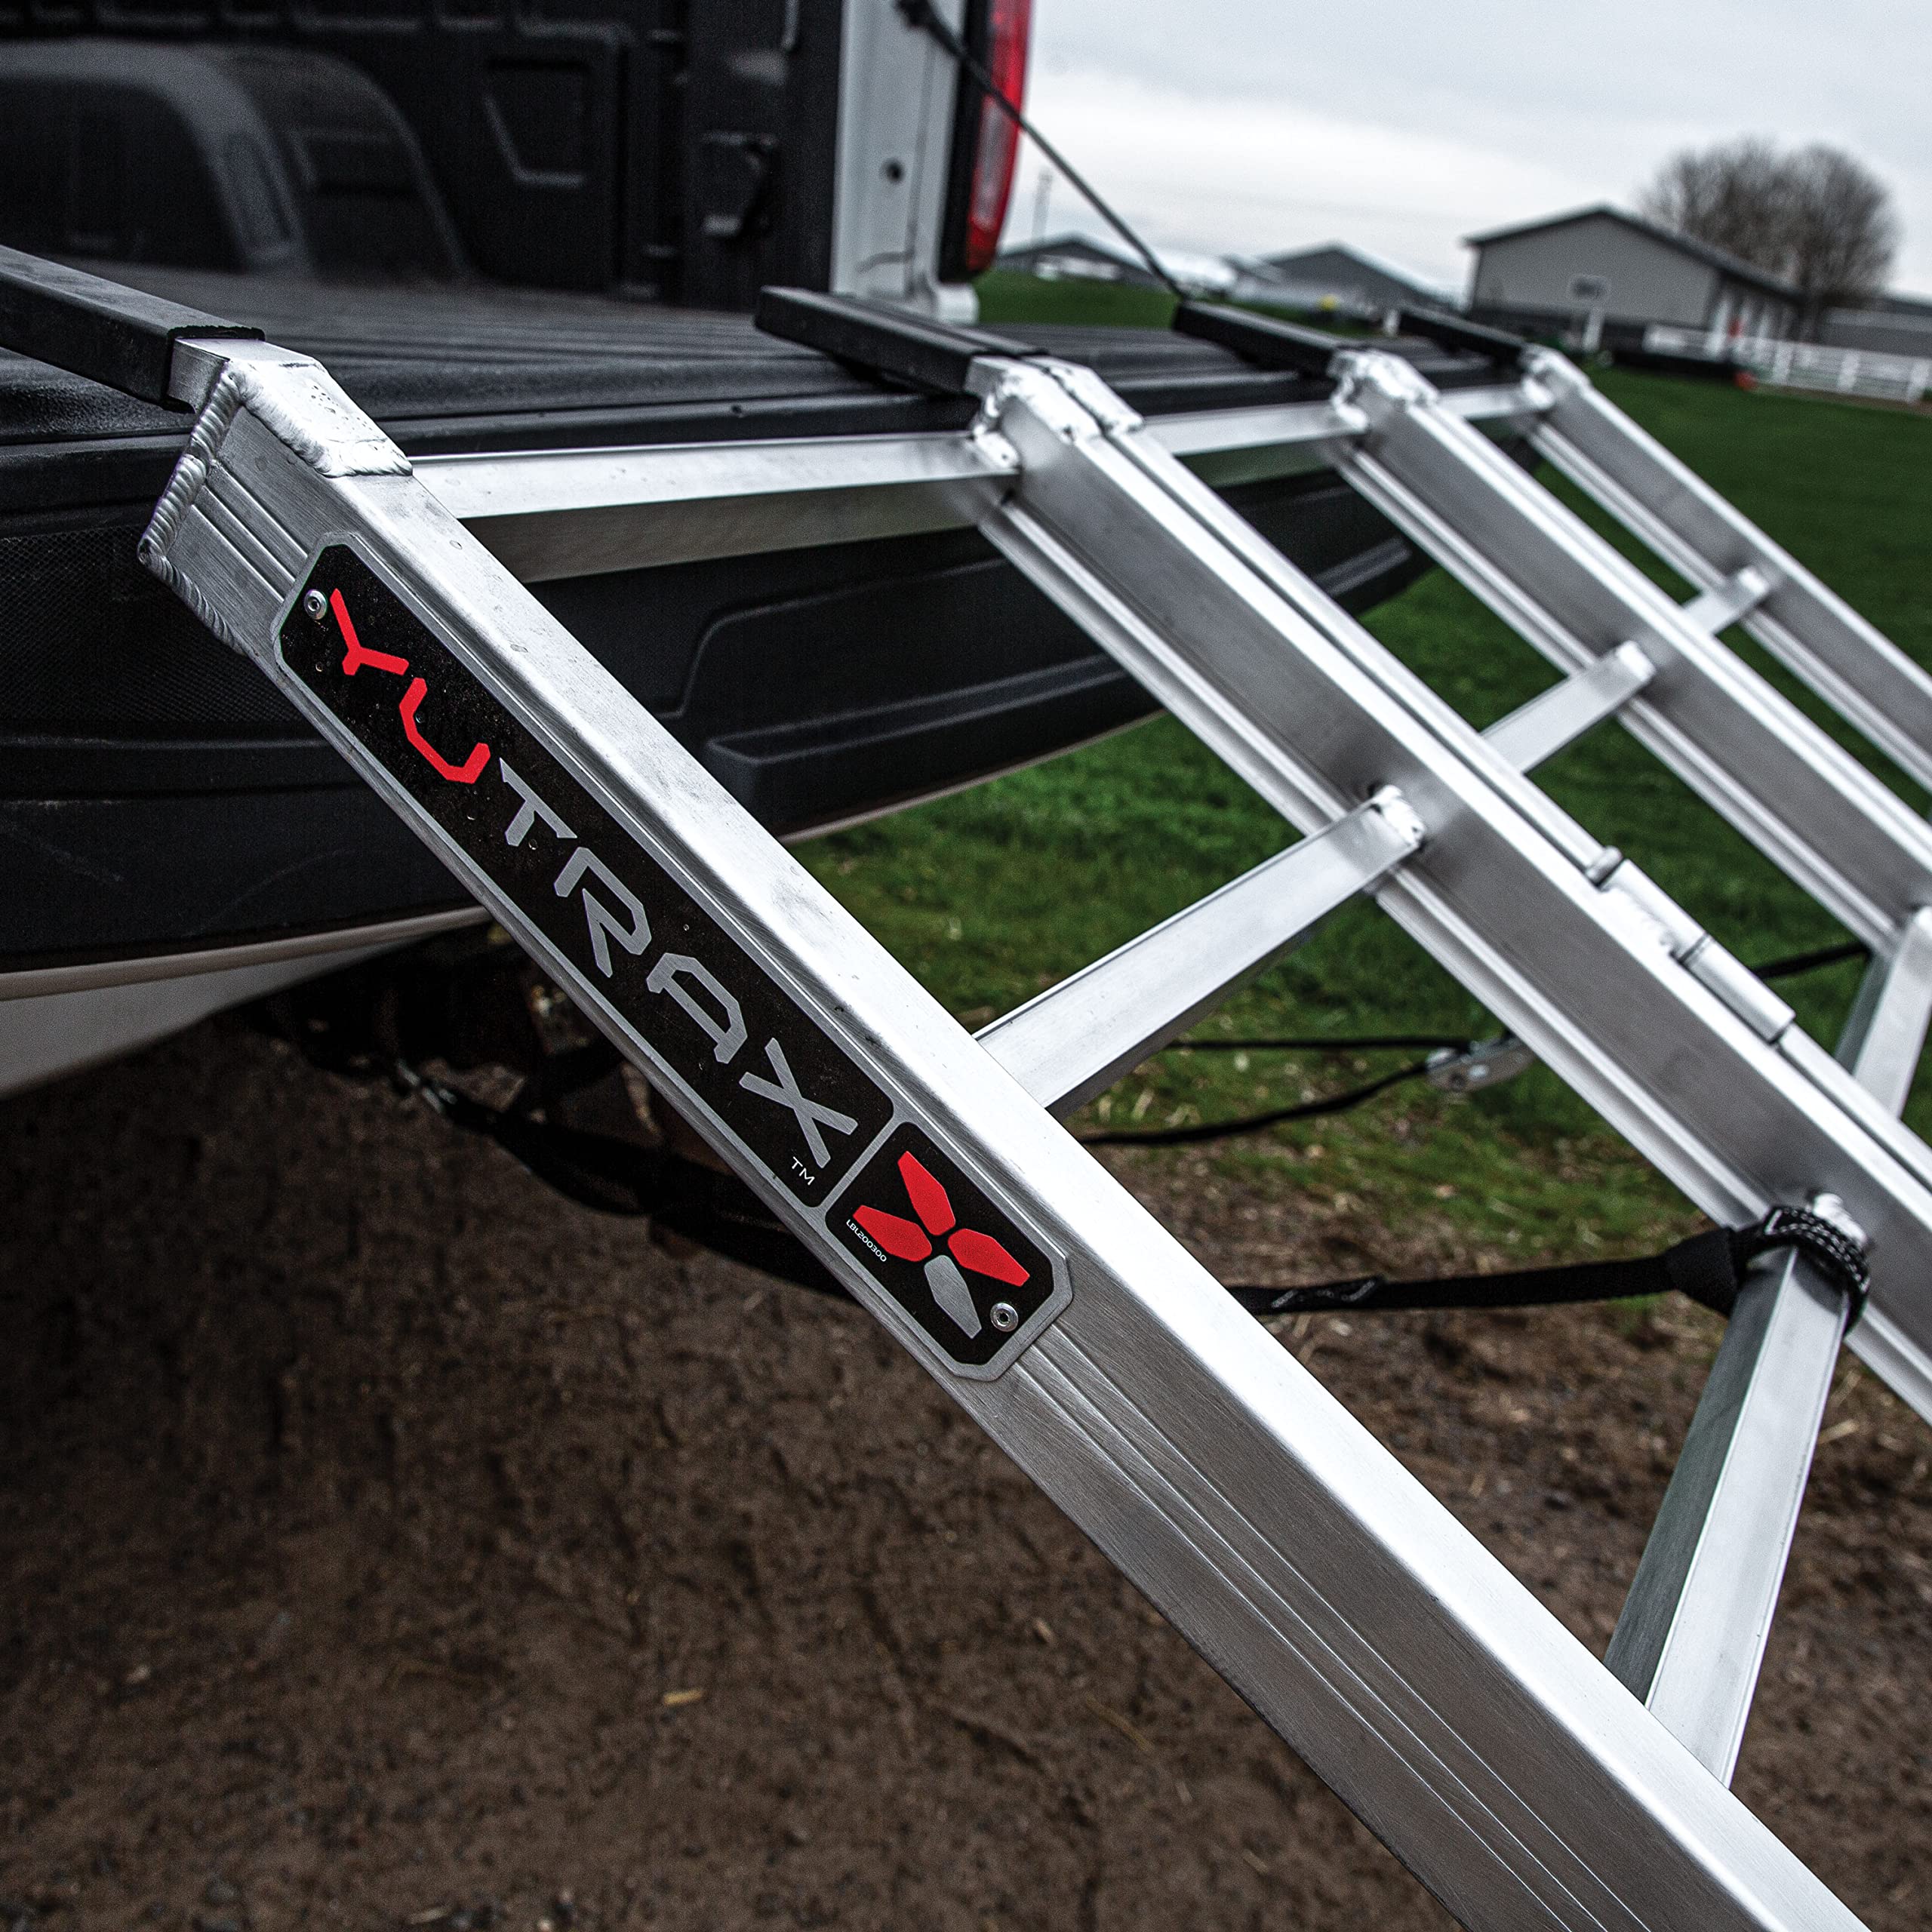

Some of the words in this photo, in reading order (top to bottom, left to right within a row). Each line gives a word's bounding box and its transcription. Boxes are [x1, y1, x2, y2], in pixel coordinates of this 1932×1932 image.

[331, 588, 858, 1168] YUTRAX
[791, 1156, 815, 1186] TM
[846, 1219, 887, 1263] LBL200300
